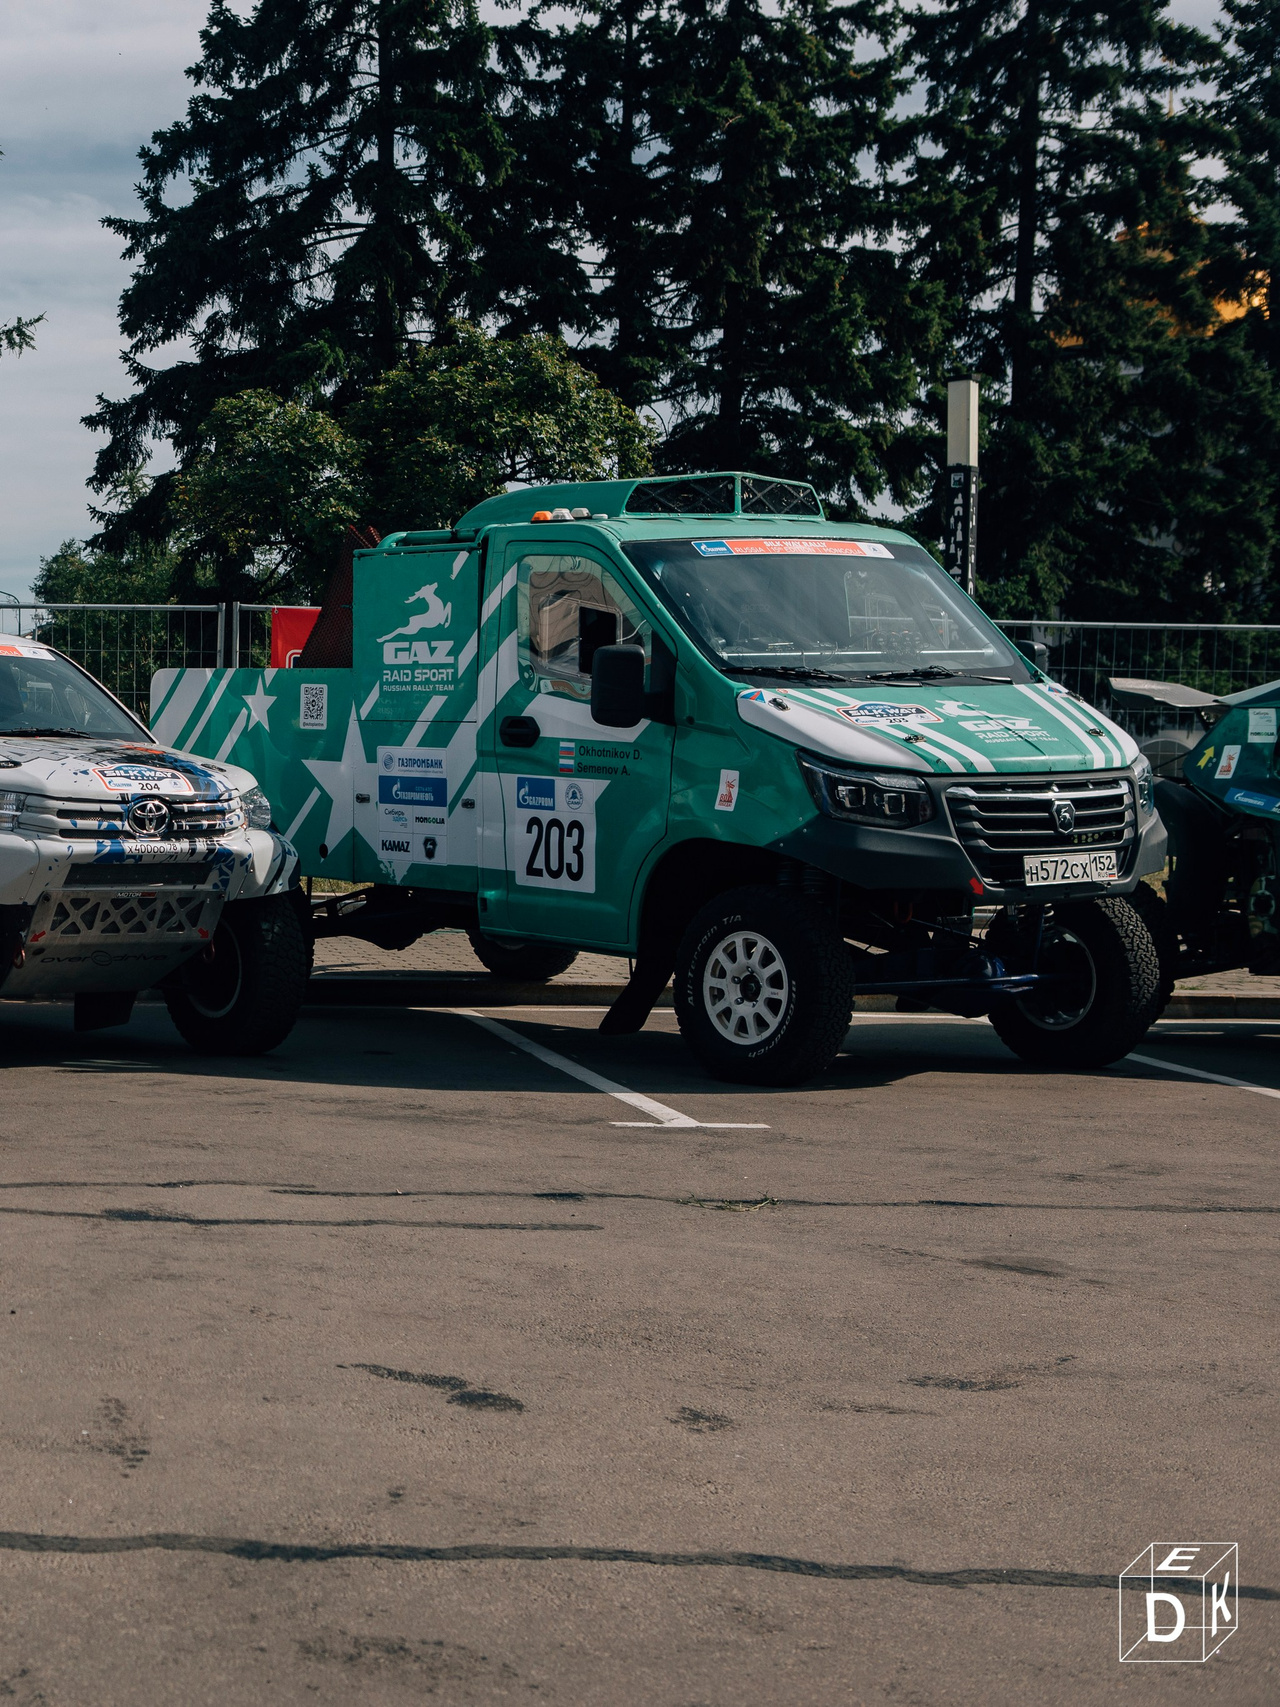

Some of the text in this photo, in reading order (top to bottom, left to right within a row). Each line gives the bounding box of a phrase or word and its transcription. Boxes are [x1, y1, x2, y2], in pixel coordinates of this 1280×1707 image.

[383, 641, 454, 664] GAZ
[383, 669, 454, 682] RAID SPORT
[849, 708, 887, 716] SILK
[958, 719, 1042, 731] GAZ
[974, 731, 1010, 739] RAID
[578, 746, 643, 761] Okhotnikov D.
[398, 757, 443, 769] ГАЗПРОМБАНК
[104, 769, 173, 778] SILK WAY
[576, 763, 631, 776] Semenov A.
[138, 782, 161, 792] 204
[384, 808, 405, 816] Сибирь
[415, 816, 445, 824] MONGOLIA
[381, 839, 410, 853] KAMAZ
[526, 816, 585, 882] 203
[1091, 855, 1113, 872] 152
[687, 914, 743, 1007] All-Terrain T/A
